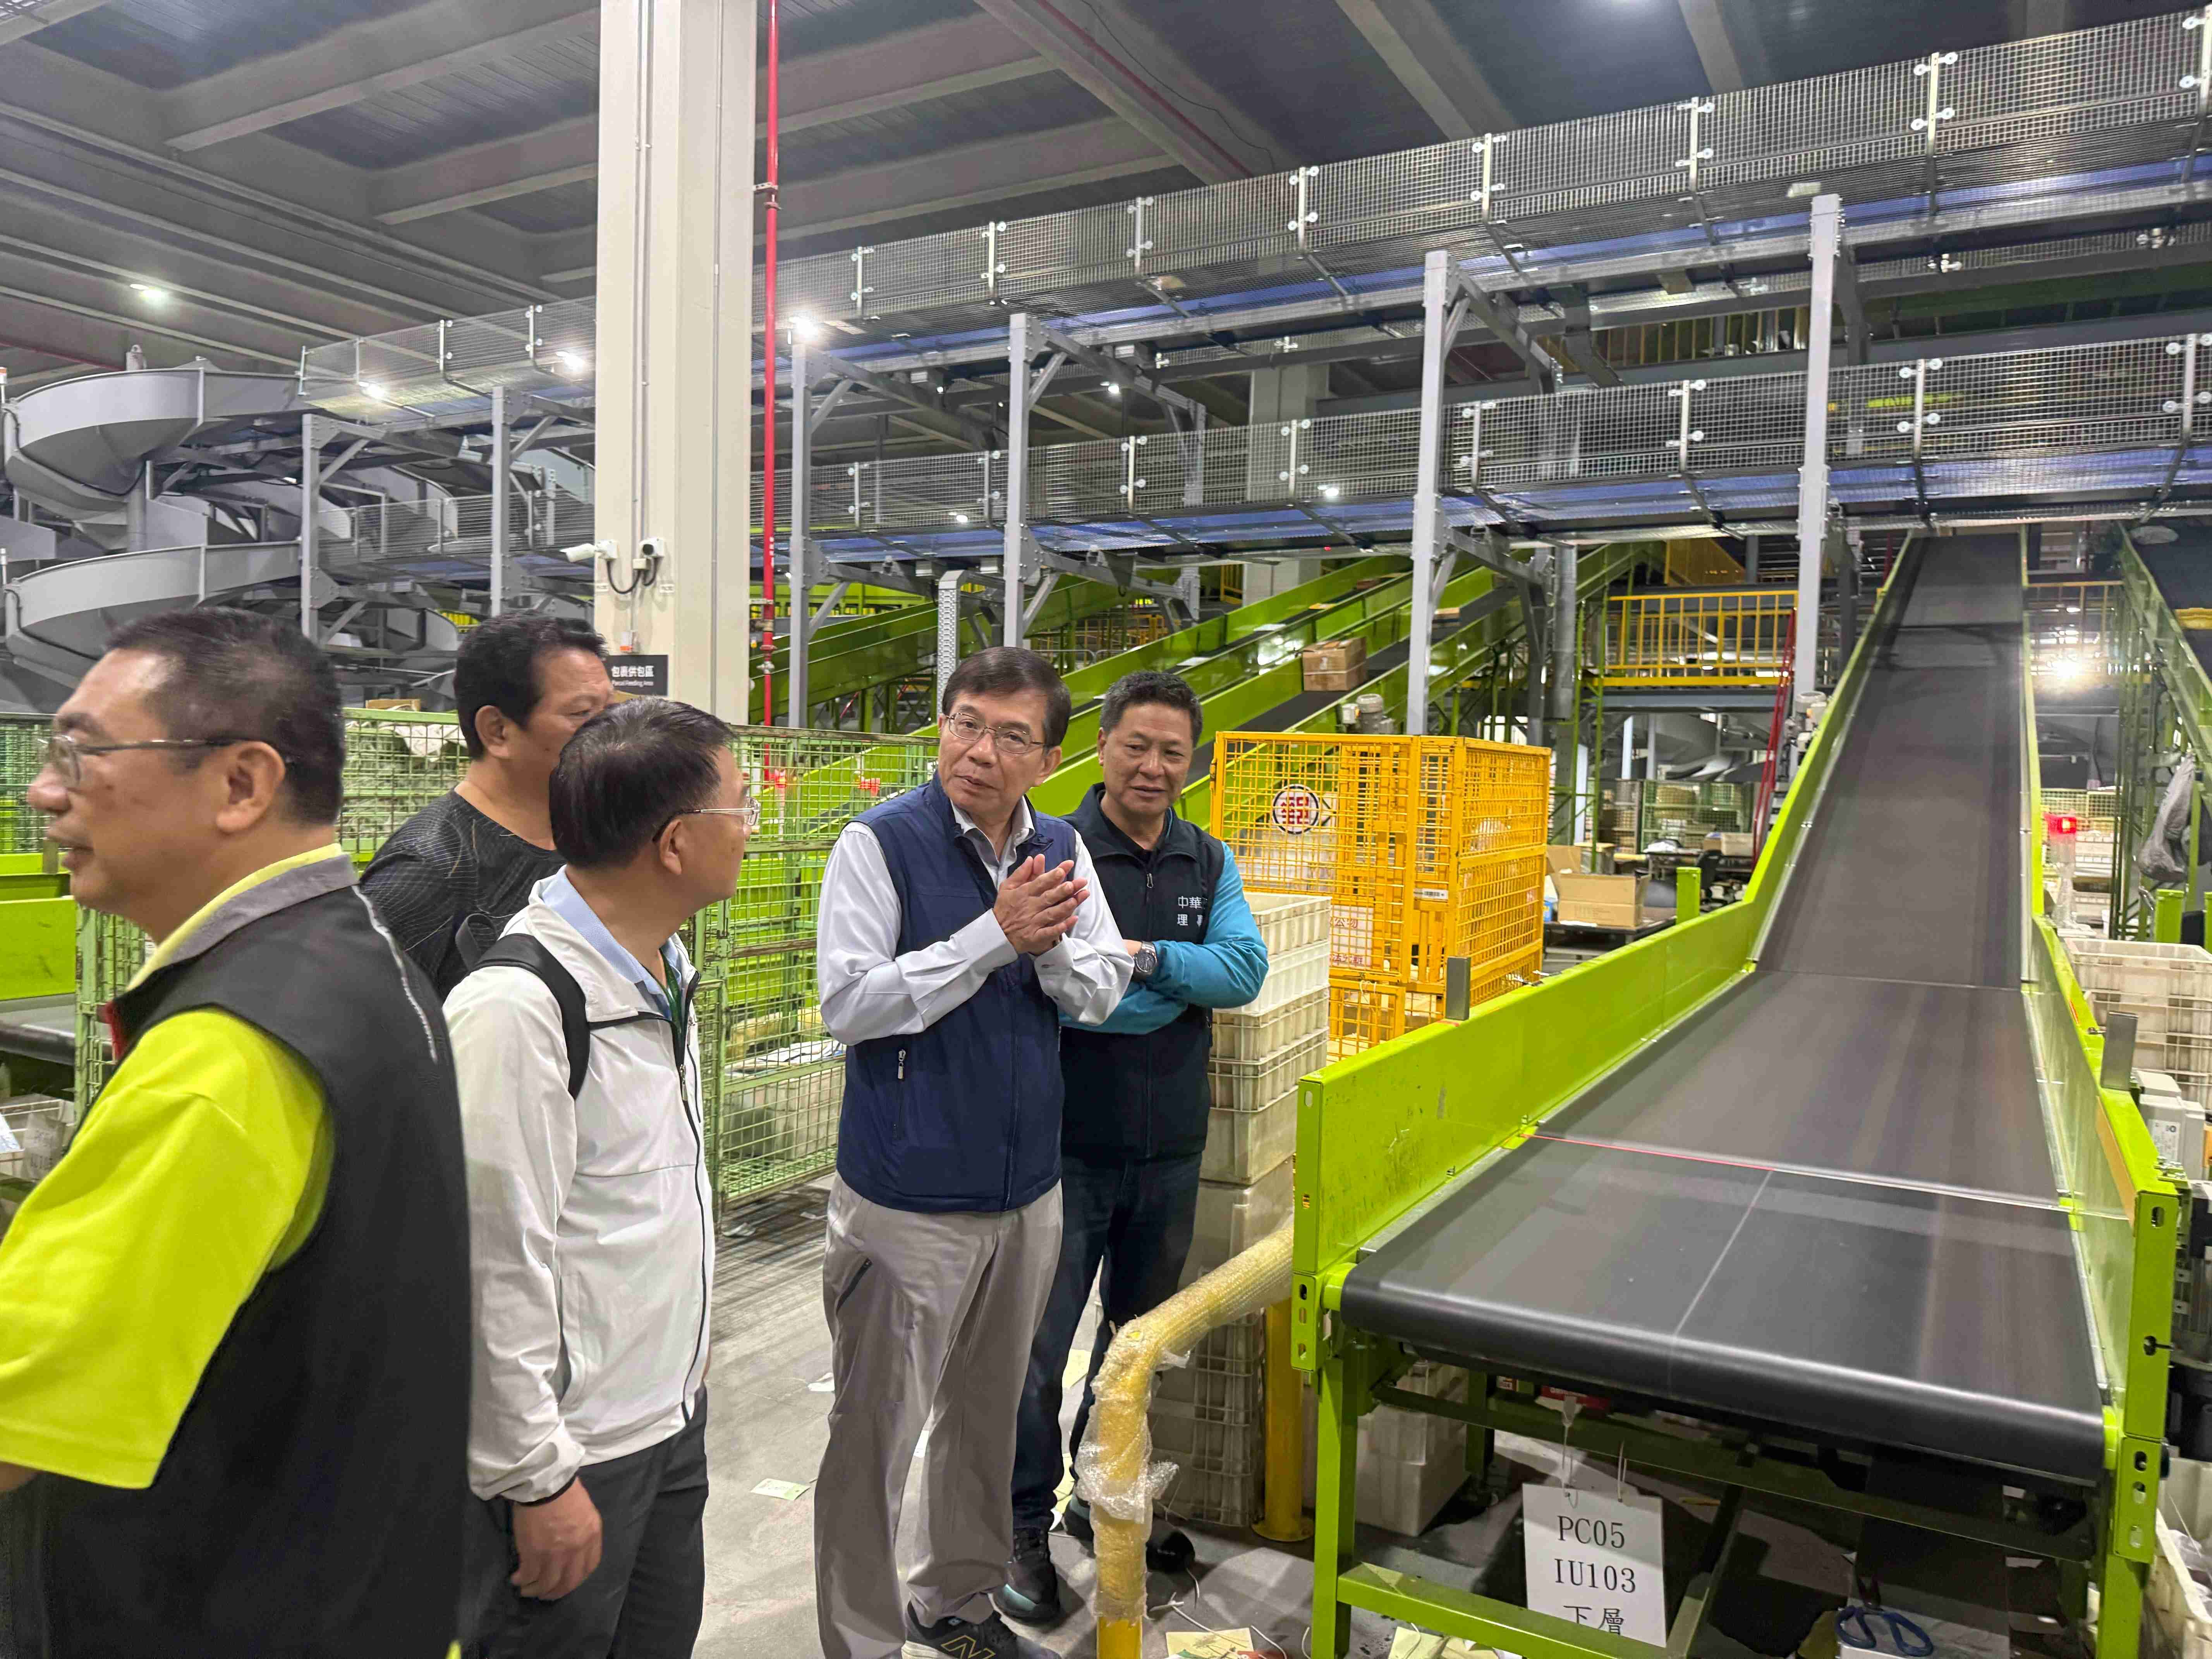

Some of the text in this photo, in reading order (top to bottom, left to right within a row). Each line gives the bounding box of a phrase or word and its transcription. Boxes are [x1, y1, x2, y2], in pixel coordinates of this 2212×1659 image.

[1557, 1515, 1625, 1549] PC05
[1554, 1558, 1636, 1593] IU103
[1563, 1605, 1625, 1636] 下層
